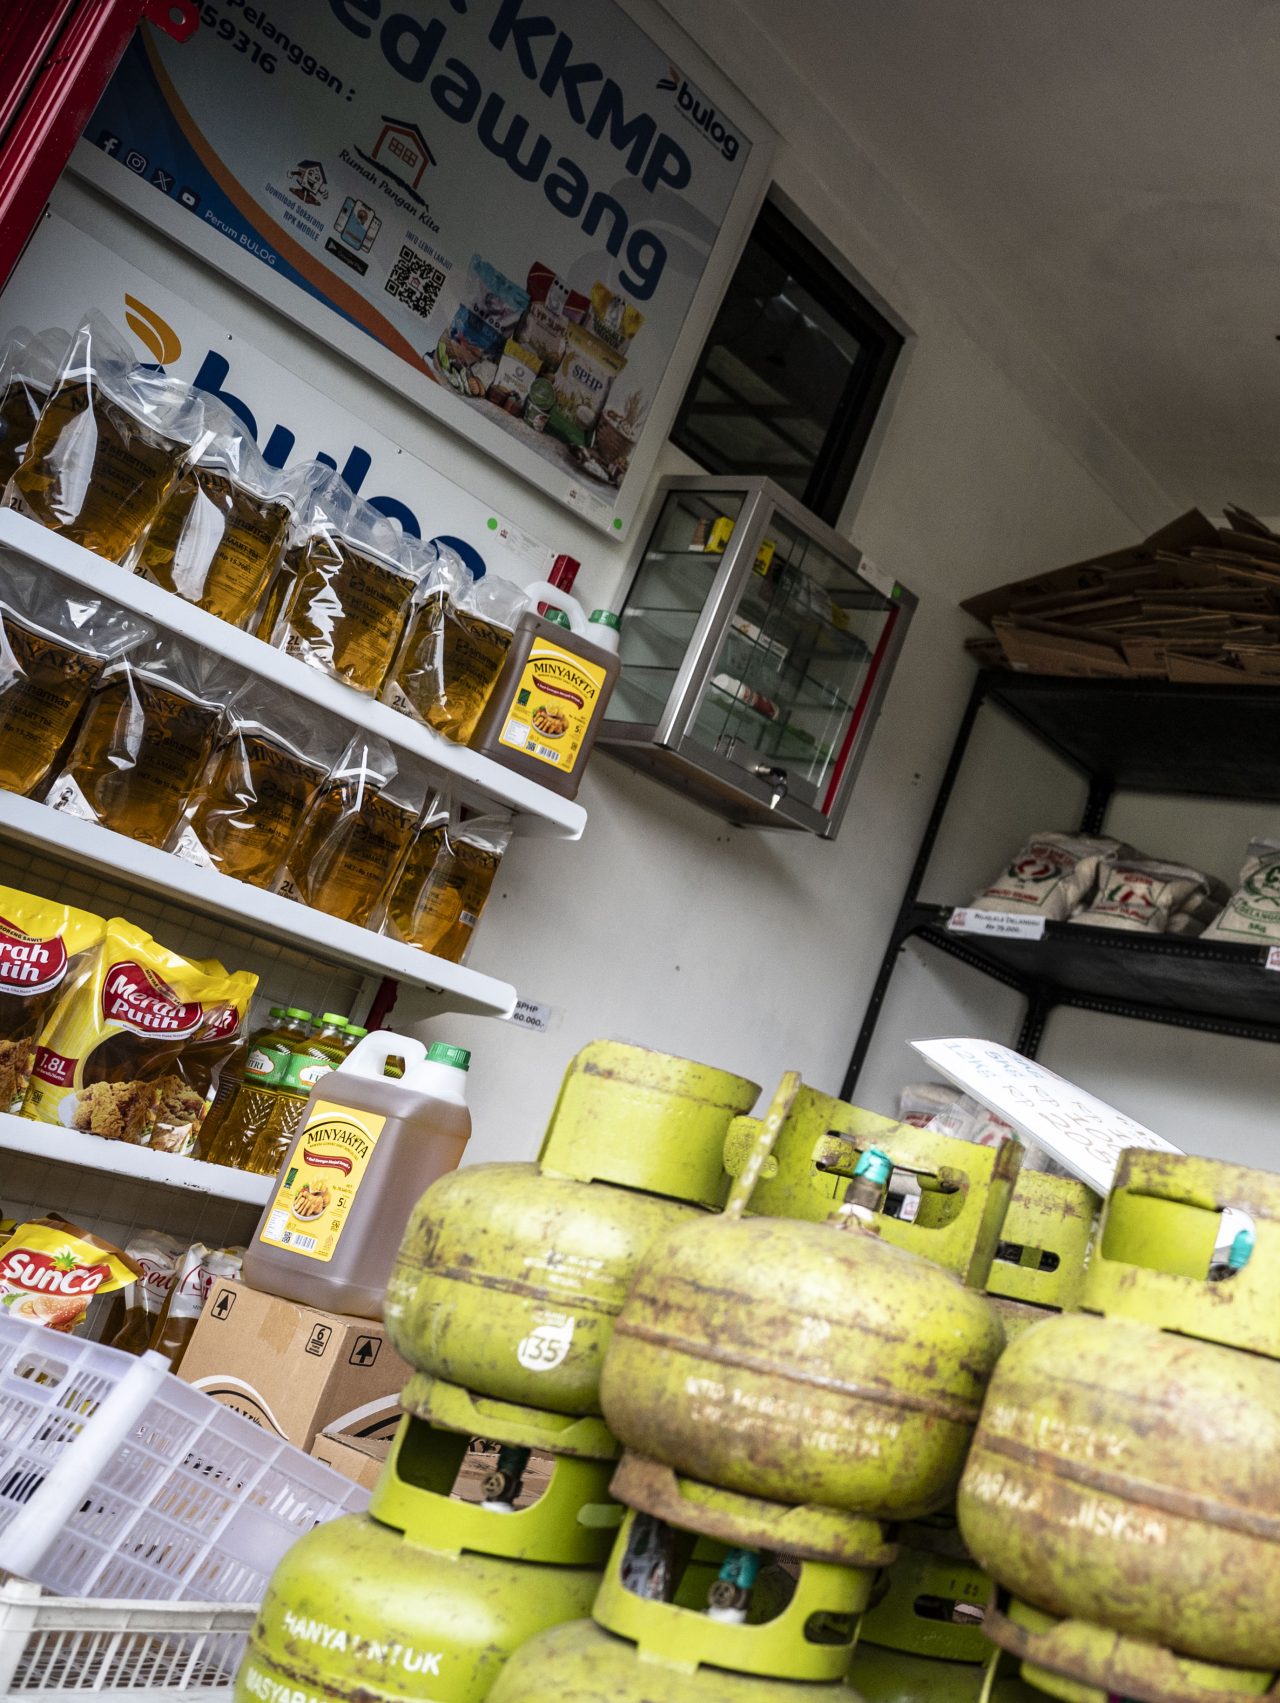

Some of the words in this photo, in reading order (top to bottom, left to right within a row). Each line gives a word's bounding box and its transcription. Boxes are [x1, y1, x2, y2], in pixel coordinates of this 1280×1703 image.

[488, 0, 692, 193] KKMP
[678, 82, 739, 161] bulog
[265, 183, 297, 210] Download
[339, 150, 376, 184] Rumah
[379, 179, 416, 216] Pangan
[418, 213, 441, 234] Kita
[205, 209, 238, 239] Perum
[239, 234, 277, 265] BULOG
[298, 222, 320, 241] MOBILE
[572, 364, 604, 392] SPHP
[11, 498, 24, 512] 2L
[287, 635, 300, 646] 2L
[534, 663, 596, 698] MINYAKITA
[392, 695, 406, 708] 2L
[281, 880, 294, 893] 2L
[0, 942, 49, 964] rah
[0, 961, 40, 983] tih
[110, 975, 186, 1018] Merah
[516, 1001, 538, 1012] SPHP
[111, 999, 179, 1029] Putih
[40, 1053, 66, 1076] 1.8L
[307, 1129, 369, 1159] MINYAKITA
[3, 1253, 103, 1293] SunCo
[317, 1328, 326, 1340] 6
[522, 1335, 561, 1363] 135
[282, 1611, 347, 1653] HANYA
